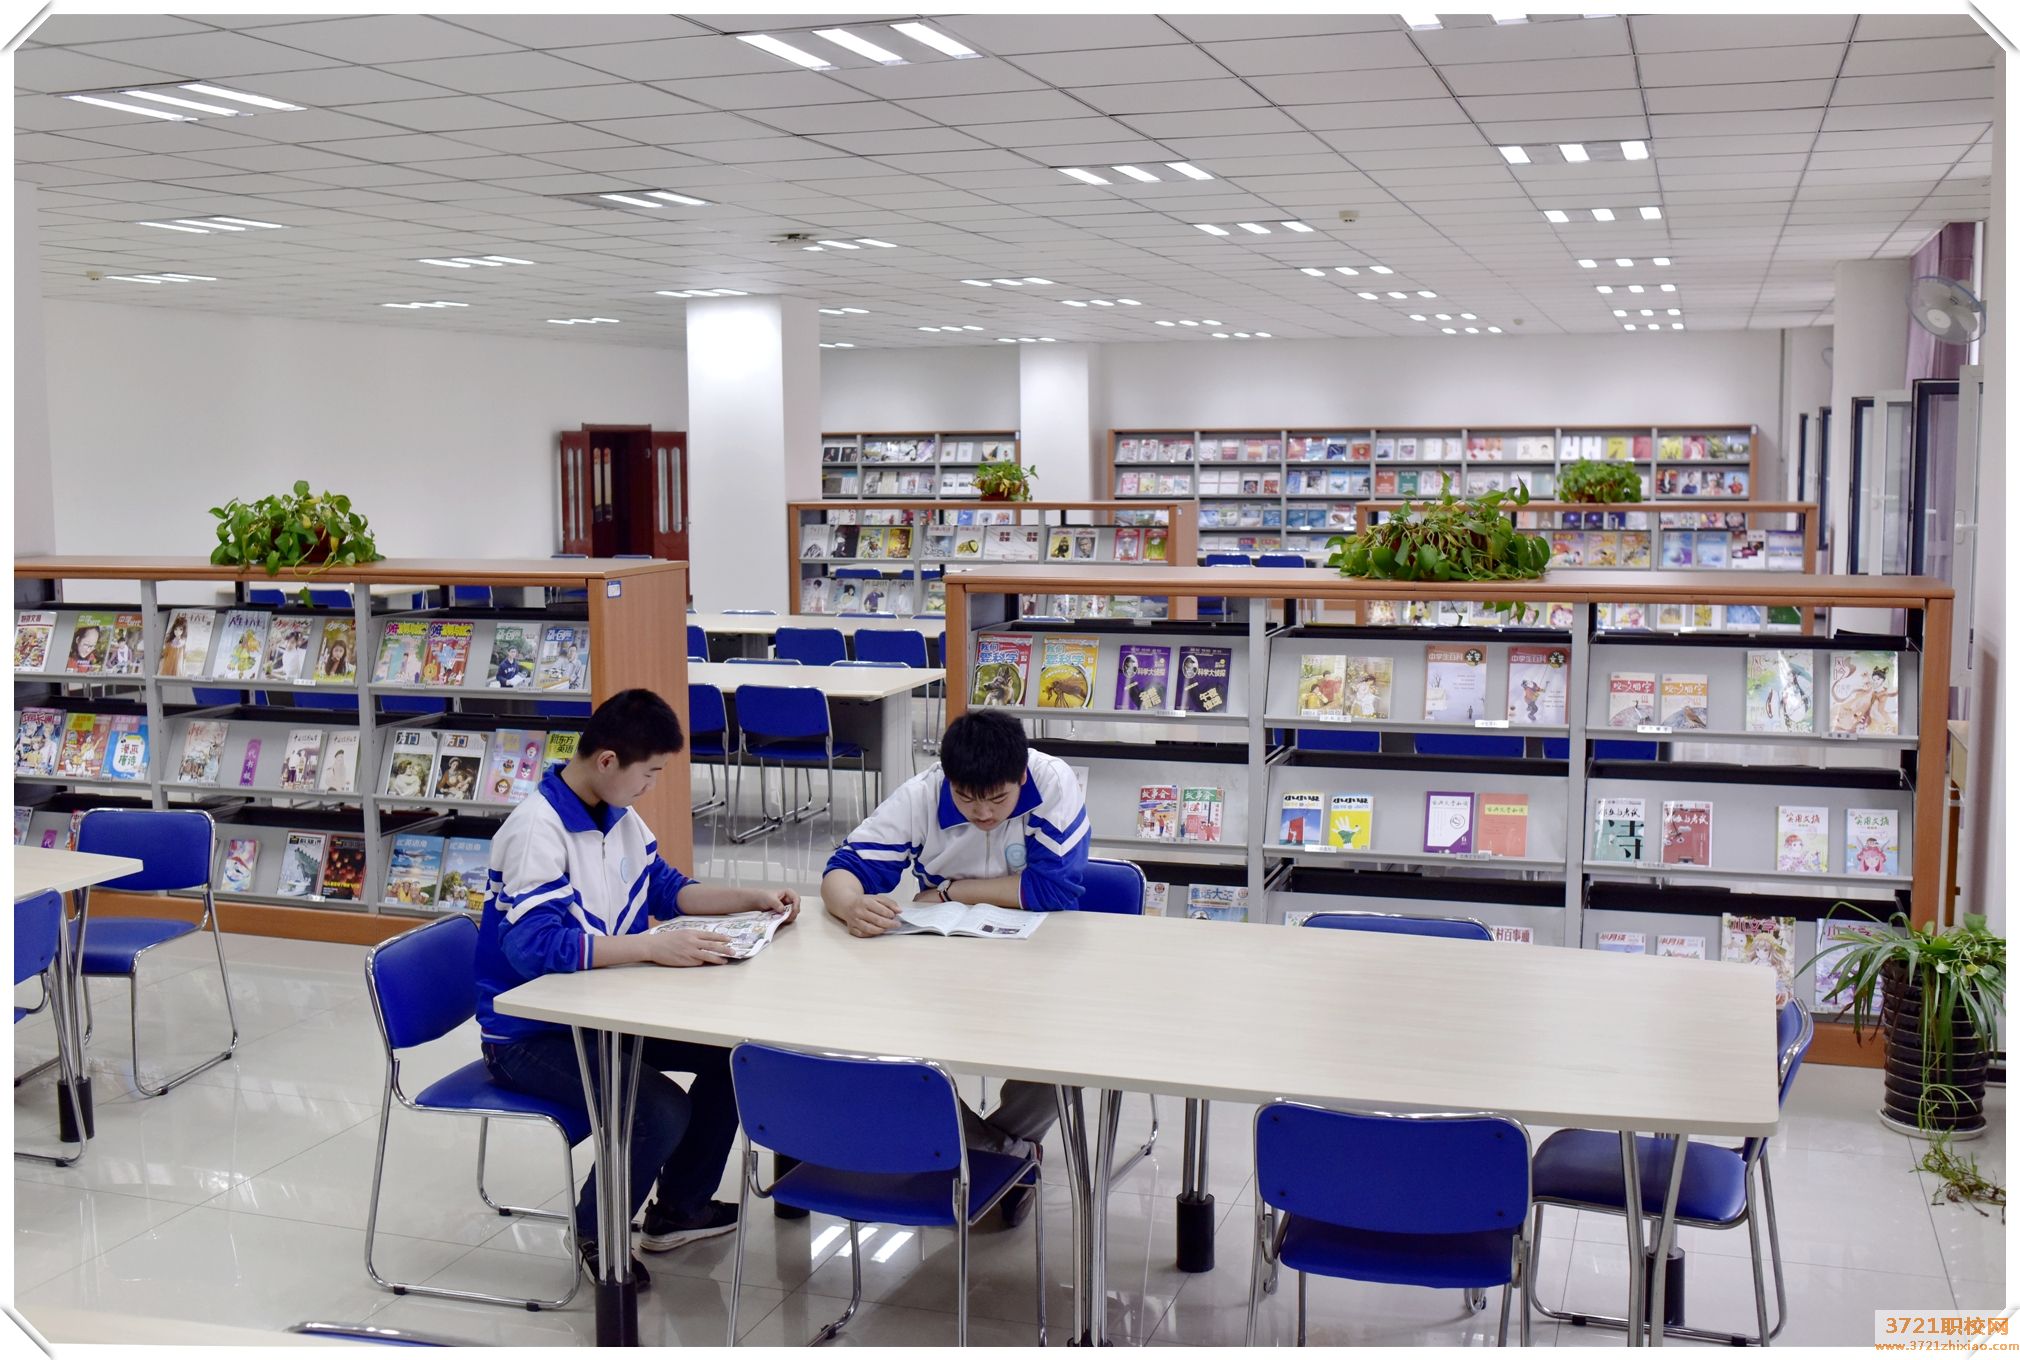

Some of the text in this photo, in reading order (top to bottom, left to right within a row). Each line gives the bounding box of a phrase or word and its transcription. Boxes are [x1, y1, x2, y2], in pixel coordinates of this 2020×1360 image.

[1613, 681, 1652, 693] 咬文嚼字
[1665, 683, 1703, 696] 咬文嚼字
[1142, 788, 1171, 800] 故事会
[1185, 790, 1216, 801] 故事会
[1191, 887, 1234, 901] 童话大王
[1490, 927, 1530, 942] 村百事通
